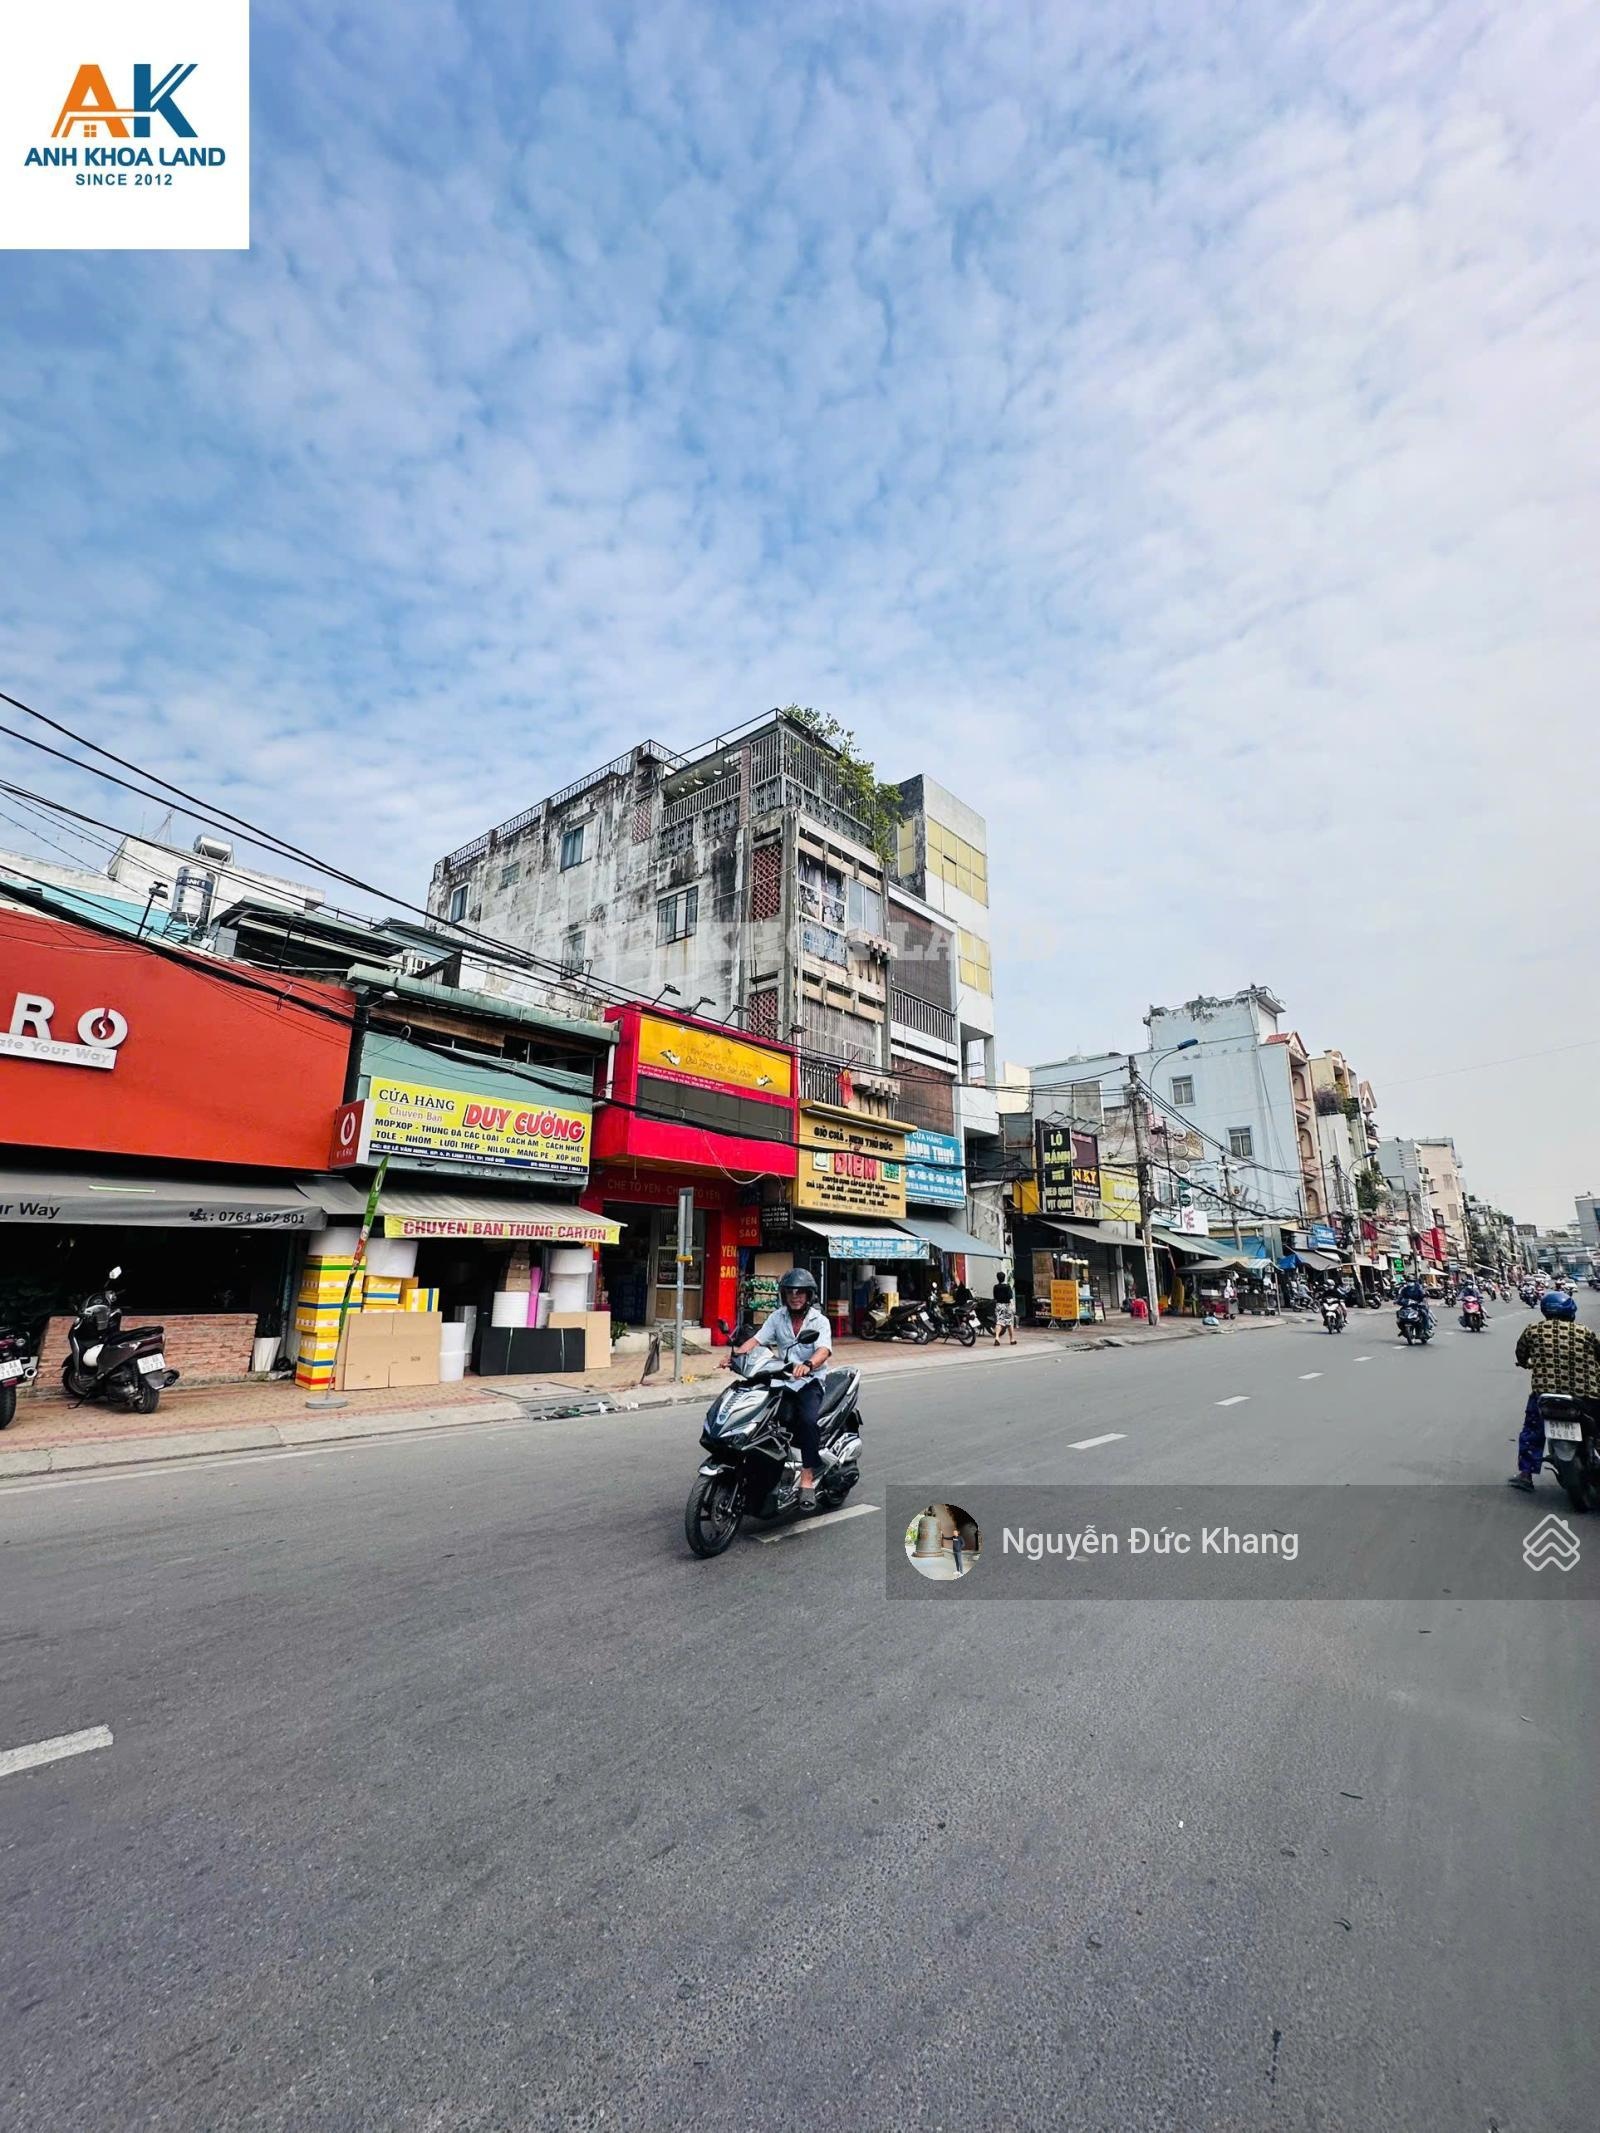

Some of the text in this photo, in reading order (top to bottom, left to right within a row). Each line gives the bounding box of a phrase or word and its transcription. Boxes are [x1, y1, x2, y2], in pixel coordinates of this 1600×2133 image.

[31, 1041, 69, 1054] Your
[76, 1047, 111, 1063] Way
[463, 1103, 585, 1142] DUY CƯỜNG
[20, 1202, 61, 1219] Way
[219, 1211, 305, 1224] 0764 867 801
[558, 1226, 606, 1240] CARTON
[739, 1228, 757, 1238] SAO
[720, 1265, 737, 1278] SAO
